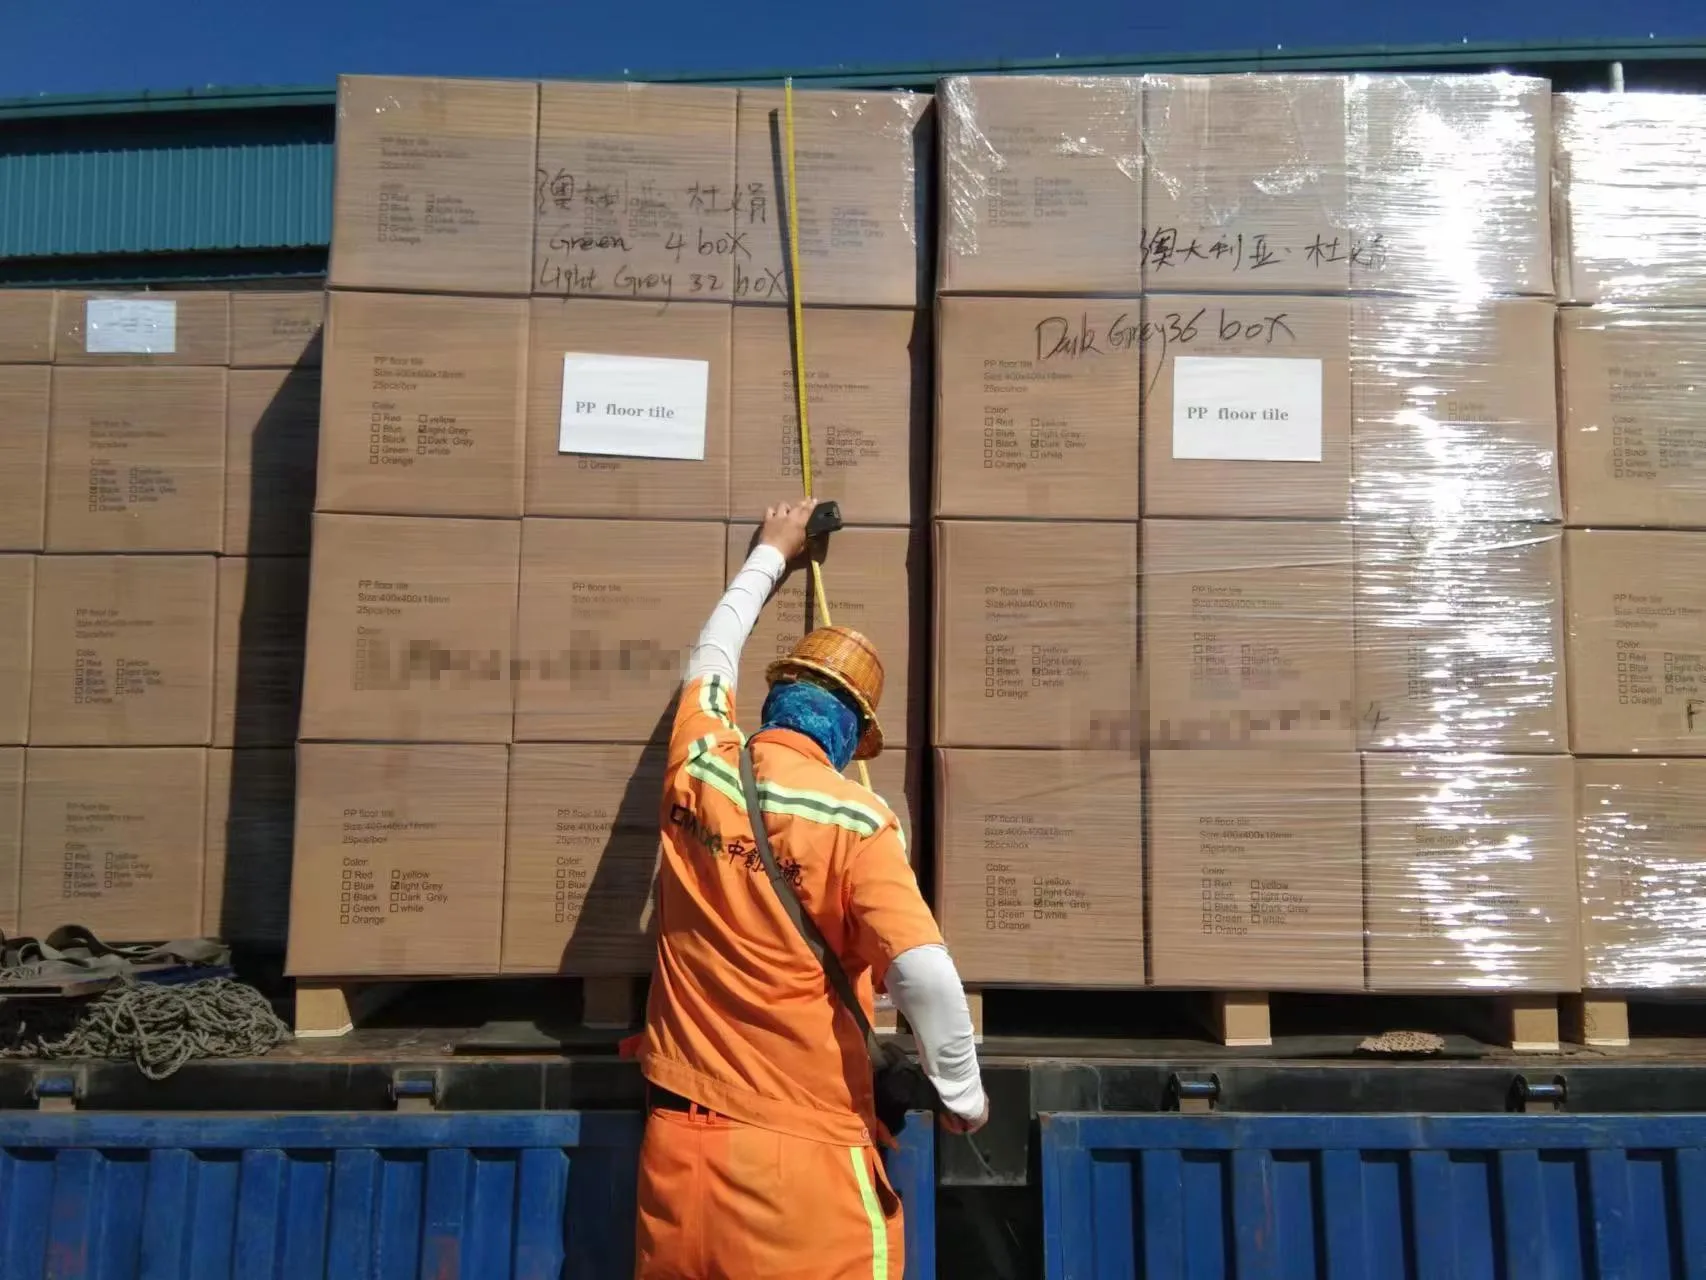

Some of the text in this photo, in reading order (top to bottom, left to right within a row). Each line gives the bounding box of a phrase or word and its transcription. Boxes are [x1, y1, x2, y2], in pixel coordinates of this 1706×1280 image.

[1166, 308, 1205, 343] 36
[575, 401, 675, 419] PP floor tile
[1187, 407, 1289, 421] PP floor tile
[344, 809, 357, 817] PP
[355, 871, 372, 880] Red
[402, 871, 430, 880] yellow
[353, 904, 380, 912] Green
